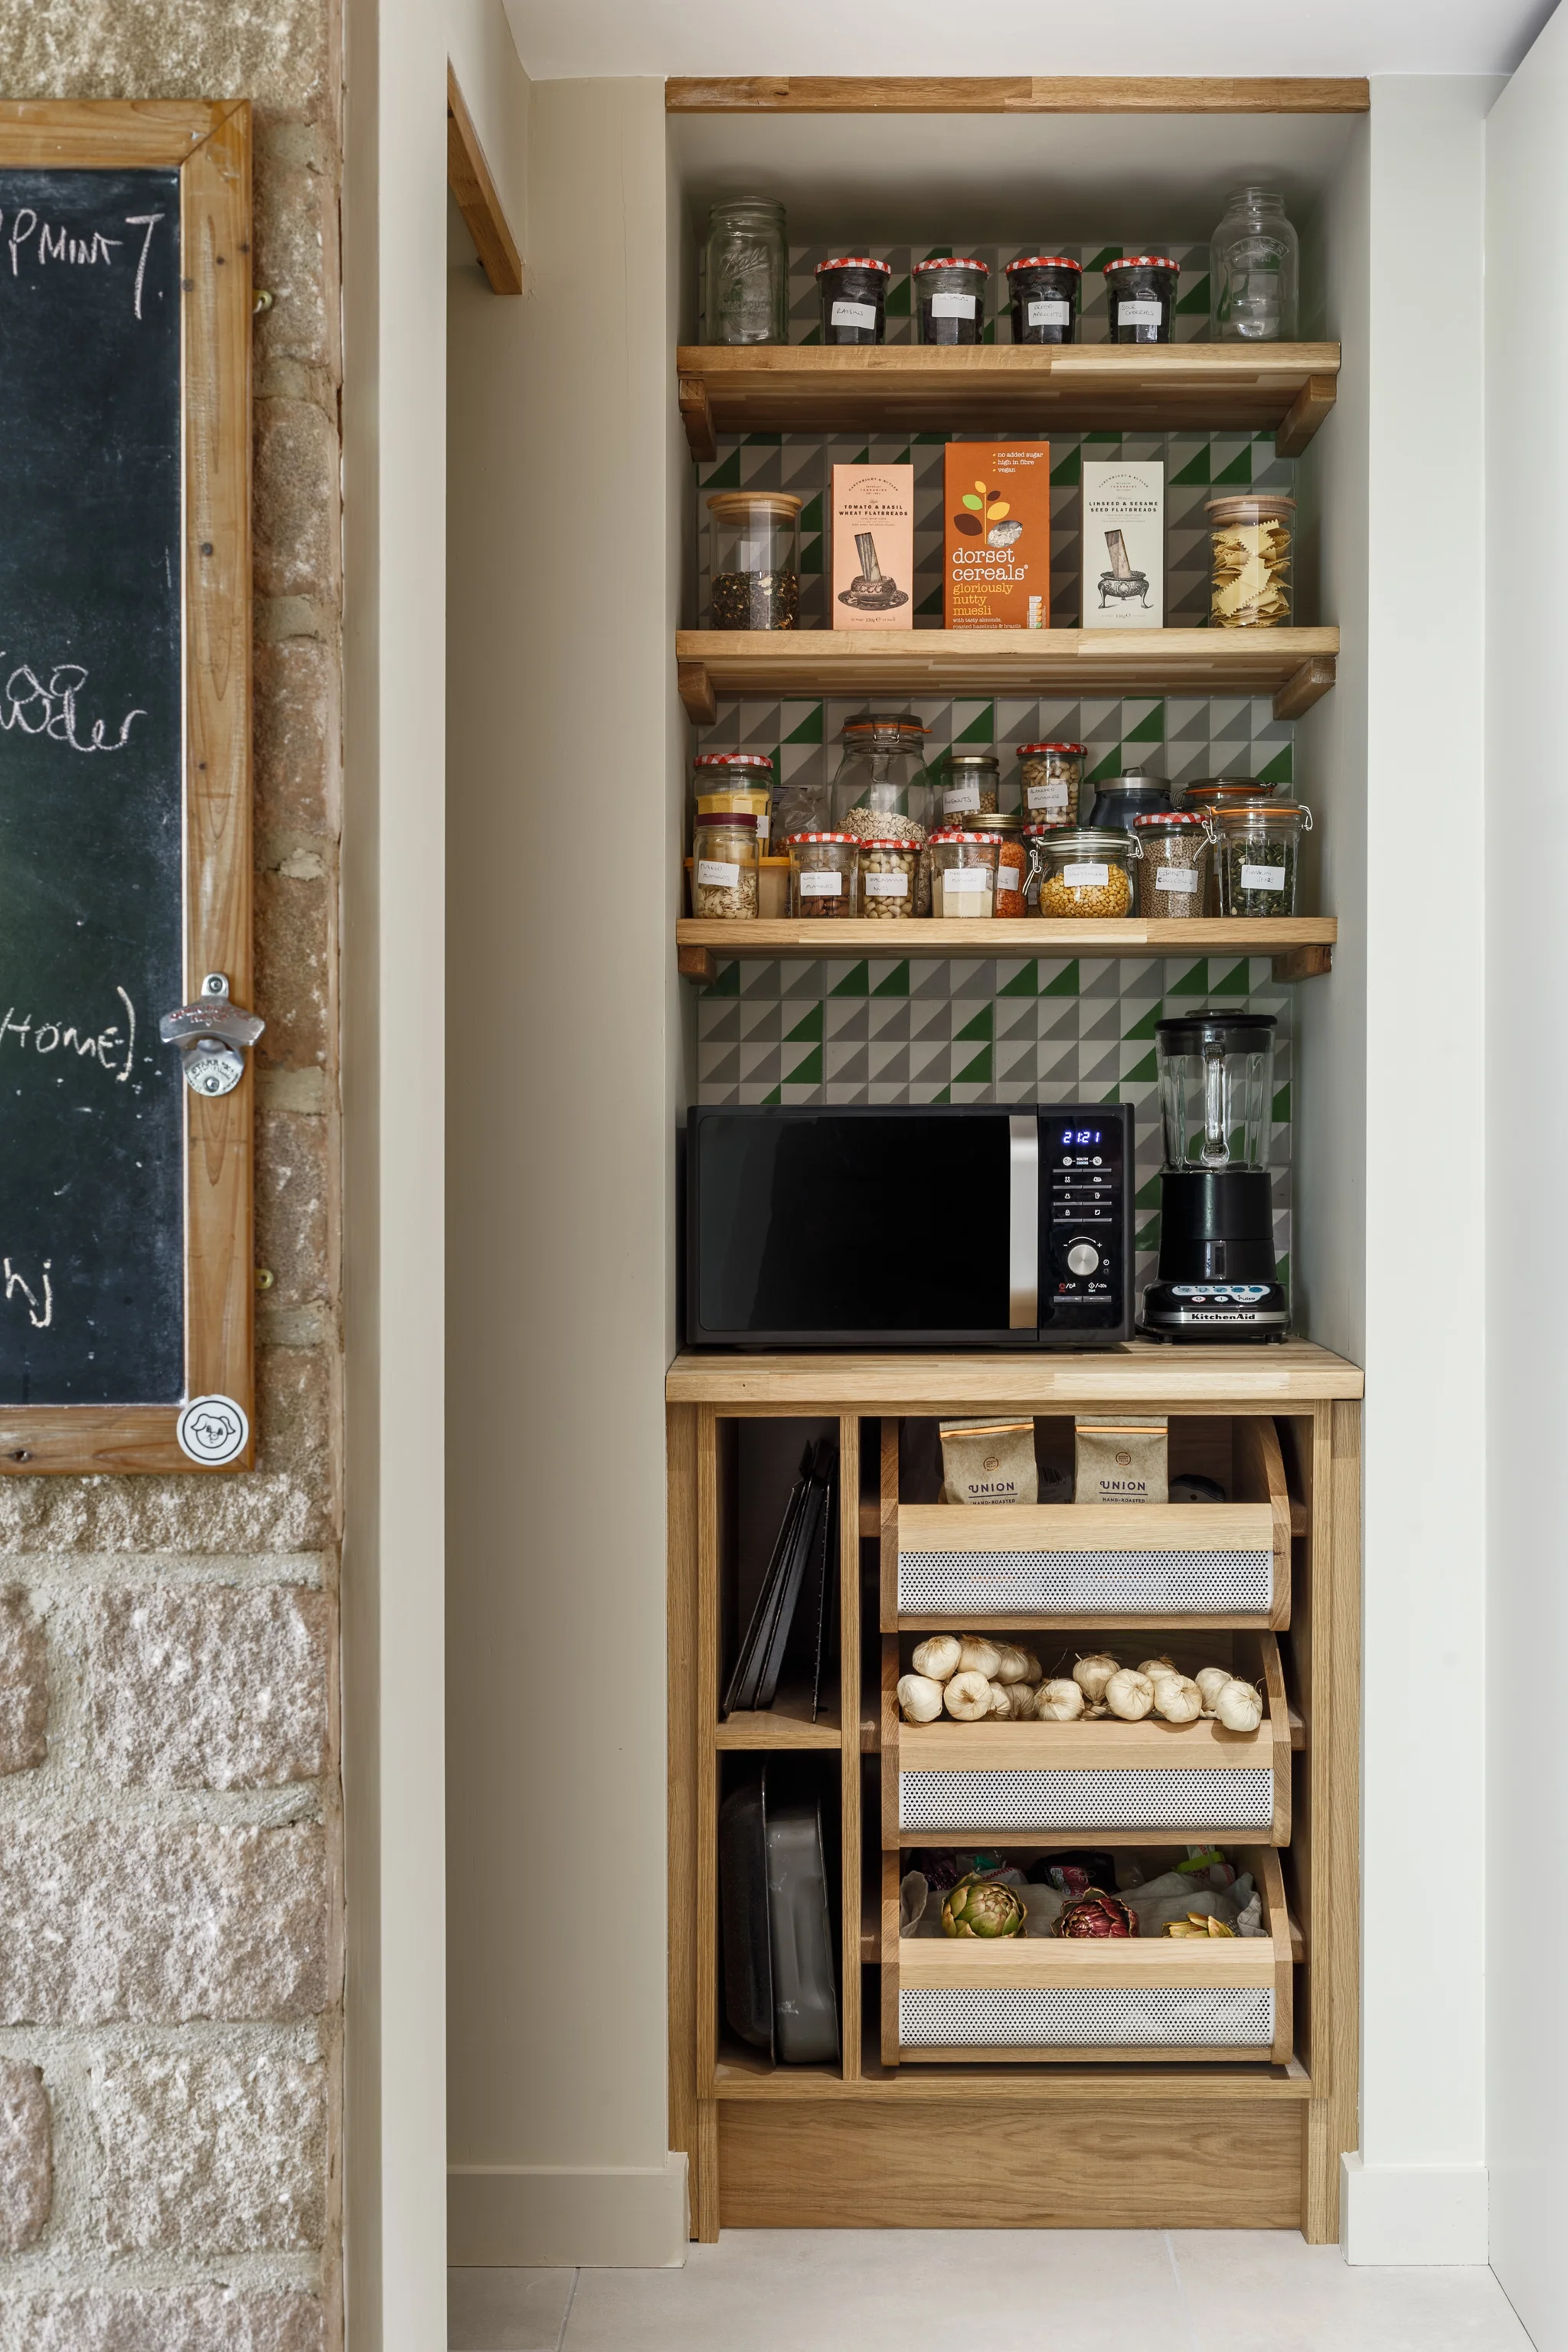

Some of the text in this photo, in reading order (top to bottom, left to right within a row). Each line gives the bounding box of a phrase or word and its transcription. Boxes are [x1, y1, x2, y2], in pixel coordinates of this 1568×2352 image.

[837, 308, 864, 316] RAISINS
[952, 547, 1015, 564] dorset
[952, 583, 1014, 596] gloriously
[952, 595, 987, 606] nutty
[952, 606, 992, 616] muesli
[1063, 1132, 1099, 1143] 21:21
[969, 1481, 1014, 1493] UNION
[1099, 1481, 1145, 1491] UNION
